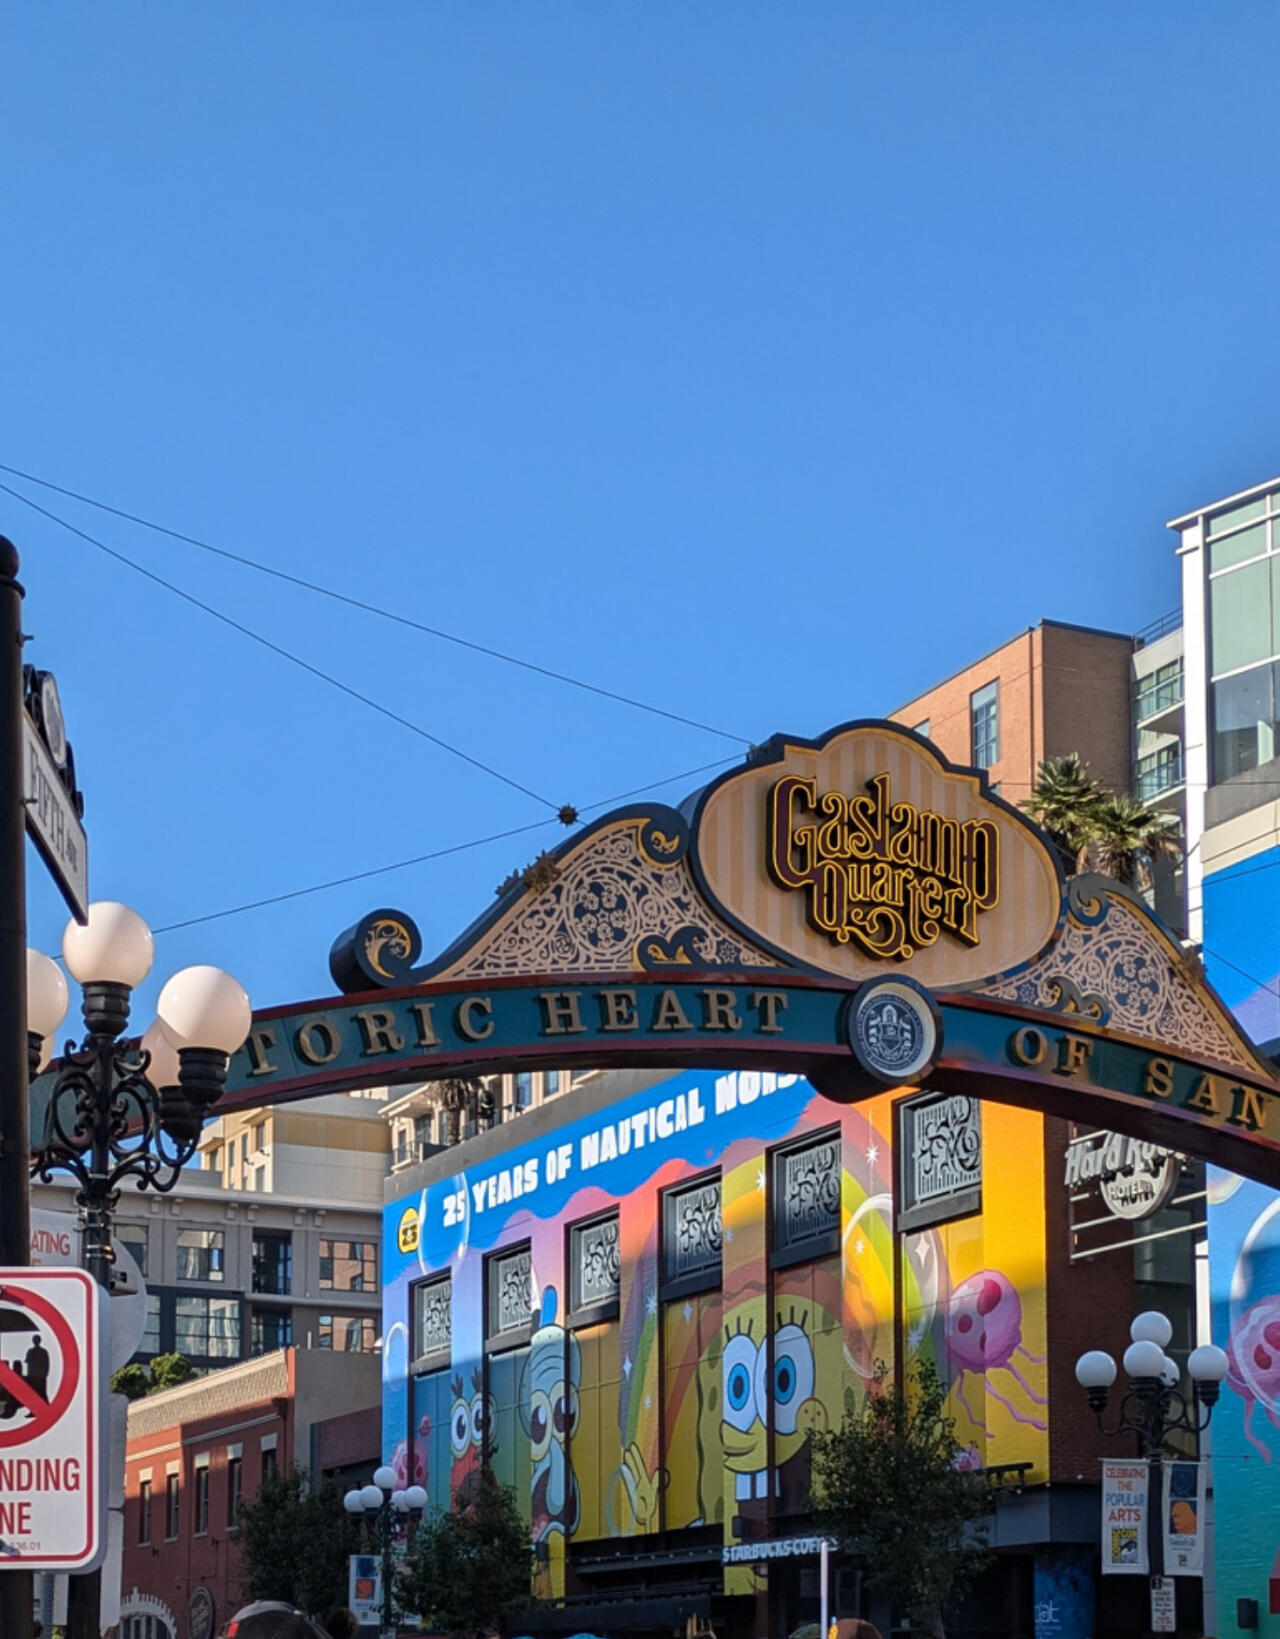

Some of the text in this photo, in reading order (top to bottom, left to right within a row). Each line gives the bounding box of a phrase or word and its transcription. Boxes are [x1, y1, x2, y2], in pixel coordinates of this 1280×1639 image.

[773, 771, 1000, 911] Gaslamp
[813, 860, 980, 958] Quarter
[250, 997, 495, 1075] TORIC
[539, 989, 789, 1034] HEART
[1014, 1026, 1094, 1074] OF
[1145, 1057, 1268, 1129] SAN
[443, 1188, 466, 1228] 25
[471, 1157, 539, 1213] YEARS
[545, 1143, 573, 1184] OF
[580, 1087, 707, 1171] NAUTICAL
[1064, 1130, 1192, 1187] Hard Ro
[31, 1230, 71, 1256] ATING
[1105, 1493, 1147, 1507] POPULAR
[1116, 1480, 1133, 1492] THE
[1108, 1508, 1142, 1522] ARTS
[722, 1541, 792, 1562] STARBUCKS
